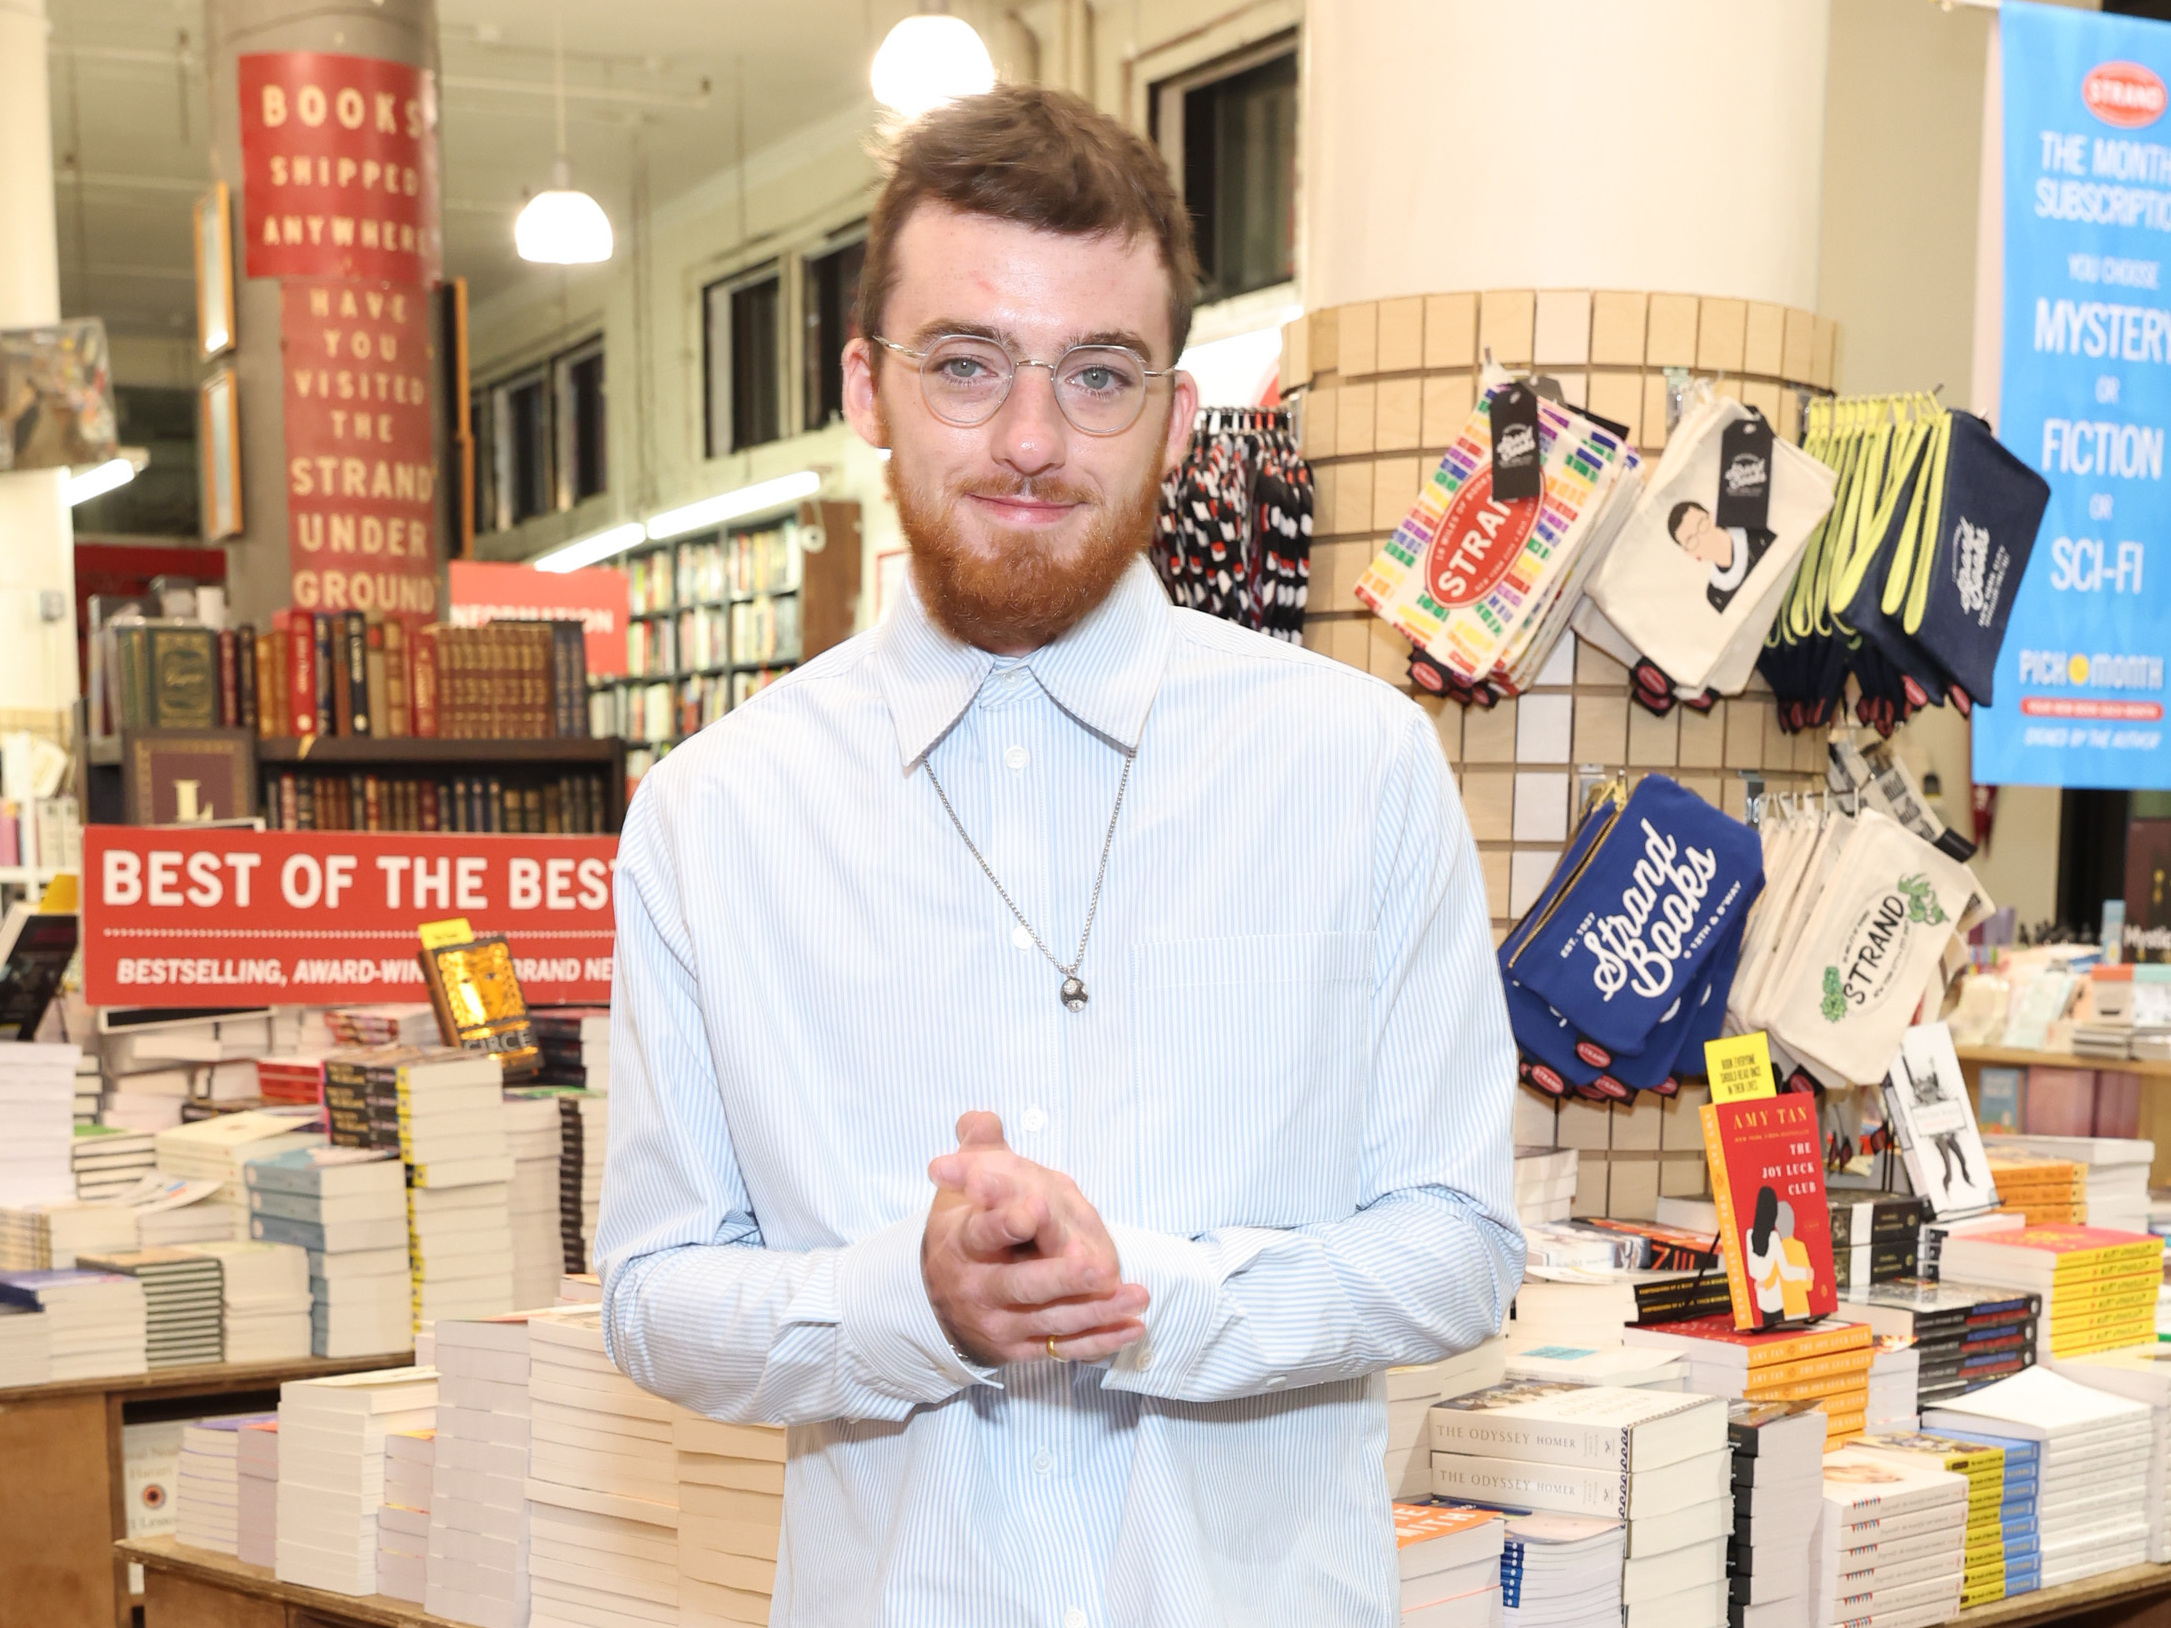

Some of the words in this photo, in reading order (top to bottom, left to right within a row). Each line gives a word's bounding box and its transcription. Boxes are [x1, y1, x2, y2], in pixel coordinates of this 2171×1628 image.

[262, 84, 422, 139] BOOKS
[2038, 130, 2088, 176] THE
[269, 153, 419, 197] SHIPPED
[310, 287, 407, 324] HAVE
[323, 328, 398, 362] YOU
[293, 368, 425, 406] VISITED
[330, 409, 394, 443] THE
[2041, 418, 2165, 480] FICTION
[290, 456, 434, 504] STRAND
[298, 512, 429, 559] UNDER
[1437, 495, 1519, 598] STRA
[2050, 536, 2144, 595] SCI-FI
[293, 570, 436, 614] GROUND
[103, 849, 262, 908] BEST
[280, 853, 358, 909] OF
[376, 856, 488, 910] THE
[508, 857, 618, 910] BES
[1583, 817, 1678, 1002] Strand
[1630, 846, 1717, 998] Books
[1843, 894, 1905, 1005] STRAND
[116, 957, 288, 988] BESTSELLING,
[292, 958, 428, 983] AWARD-WIN
[584, 959, 614, 982] NE
[464, 1029, 532, 1052] CIRCE
[1734, 1110, 1768, 1130] AMY
[1776, 1106, 1807, 1125] TAN
[1790, 1142, 1812, 1155] THE
[1762, 1165, 1782, 1179] JOY
[1786, 1162, 1814, 1176] LUCK
[1788, 1181, 1816, 1195] CLUB
[1734, 1288, 1747, 1321] CLUB
[1753, 1350, 1768, 1361] AMY
[1436, 1425, 1463, 1438] THE
[1469, 1428, 1530, 1444] ODYSSEY
[1536, 1435, 1576, 1448] HOMER
[1440, 1470, 1466, 1484] THE
[1471, 1473, 1531, 1491] ODYSSEY
[1536, 1482, 1576, 1496] HOMER
[1393, 1512, 1476, 1542] MITH
